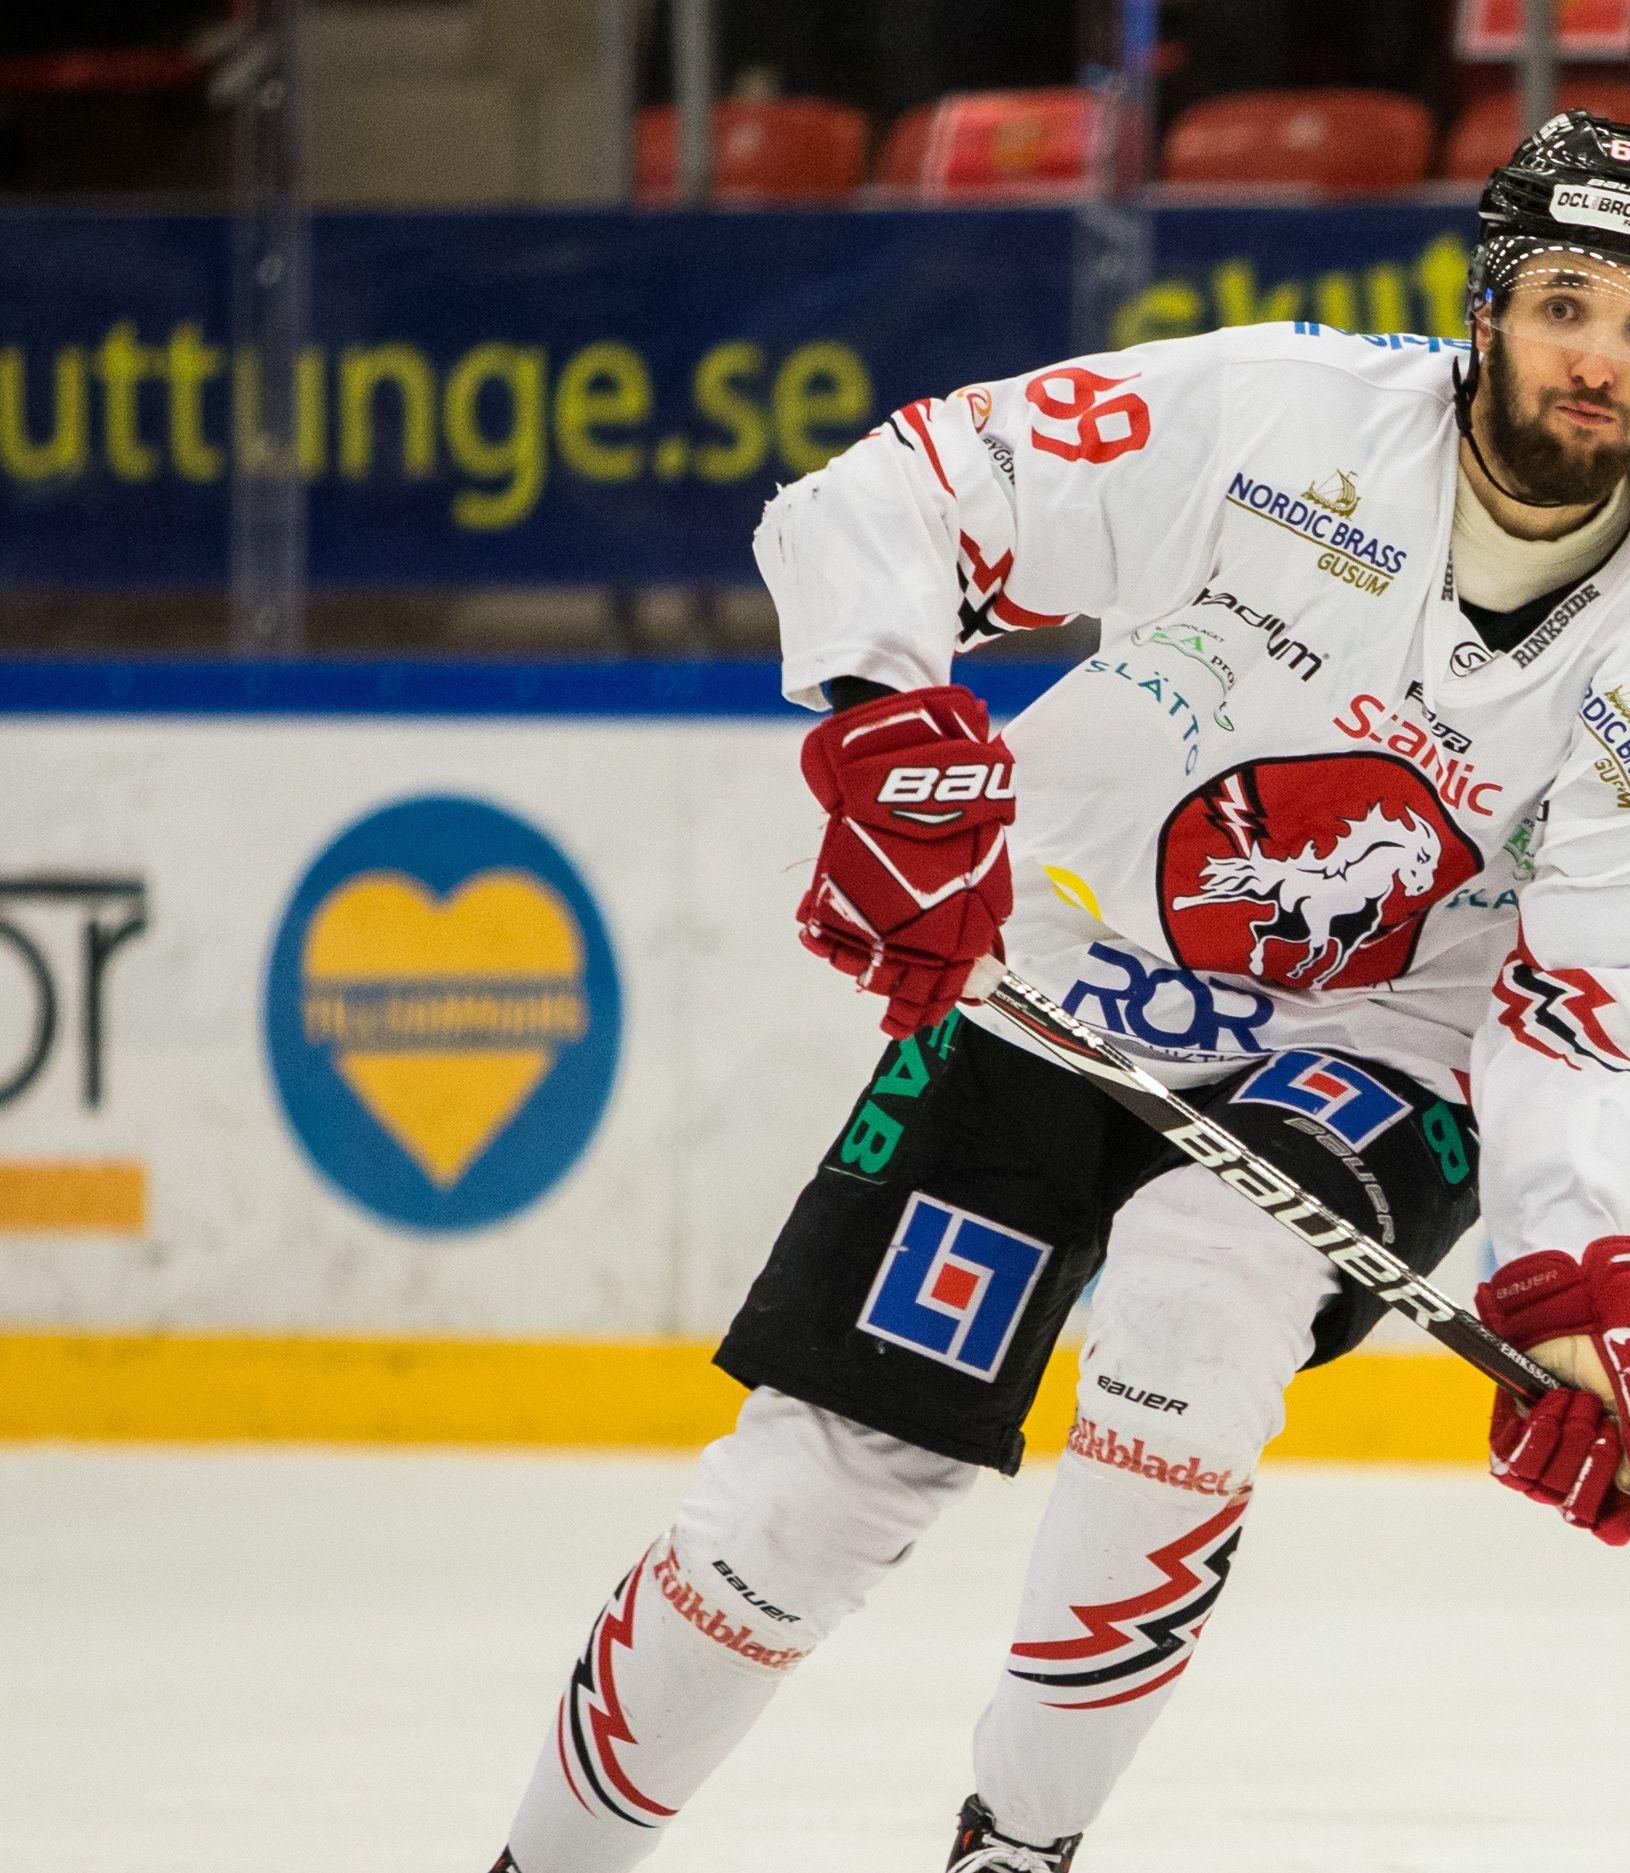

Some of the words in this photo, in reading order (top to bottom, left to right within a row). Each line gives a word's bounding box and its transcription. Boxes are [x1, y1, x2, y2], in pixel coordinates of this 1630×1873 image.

[1227, 472, 1333, 539] NORDIC
[1330, 522, 1408, 574] BRASS
[1316, 552, 1390, 597] GUSUM
[1511, 584, 1600, 670] RINKSIDE
[876, 762, 1016, 803] BAU
[1061, 941, 1275, 1054] ROR
